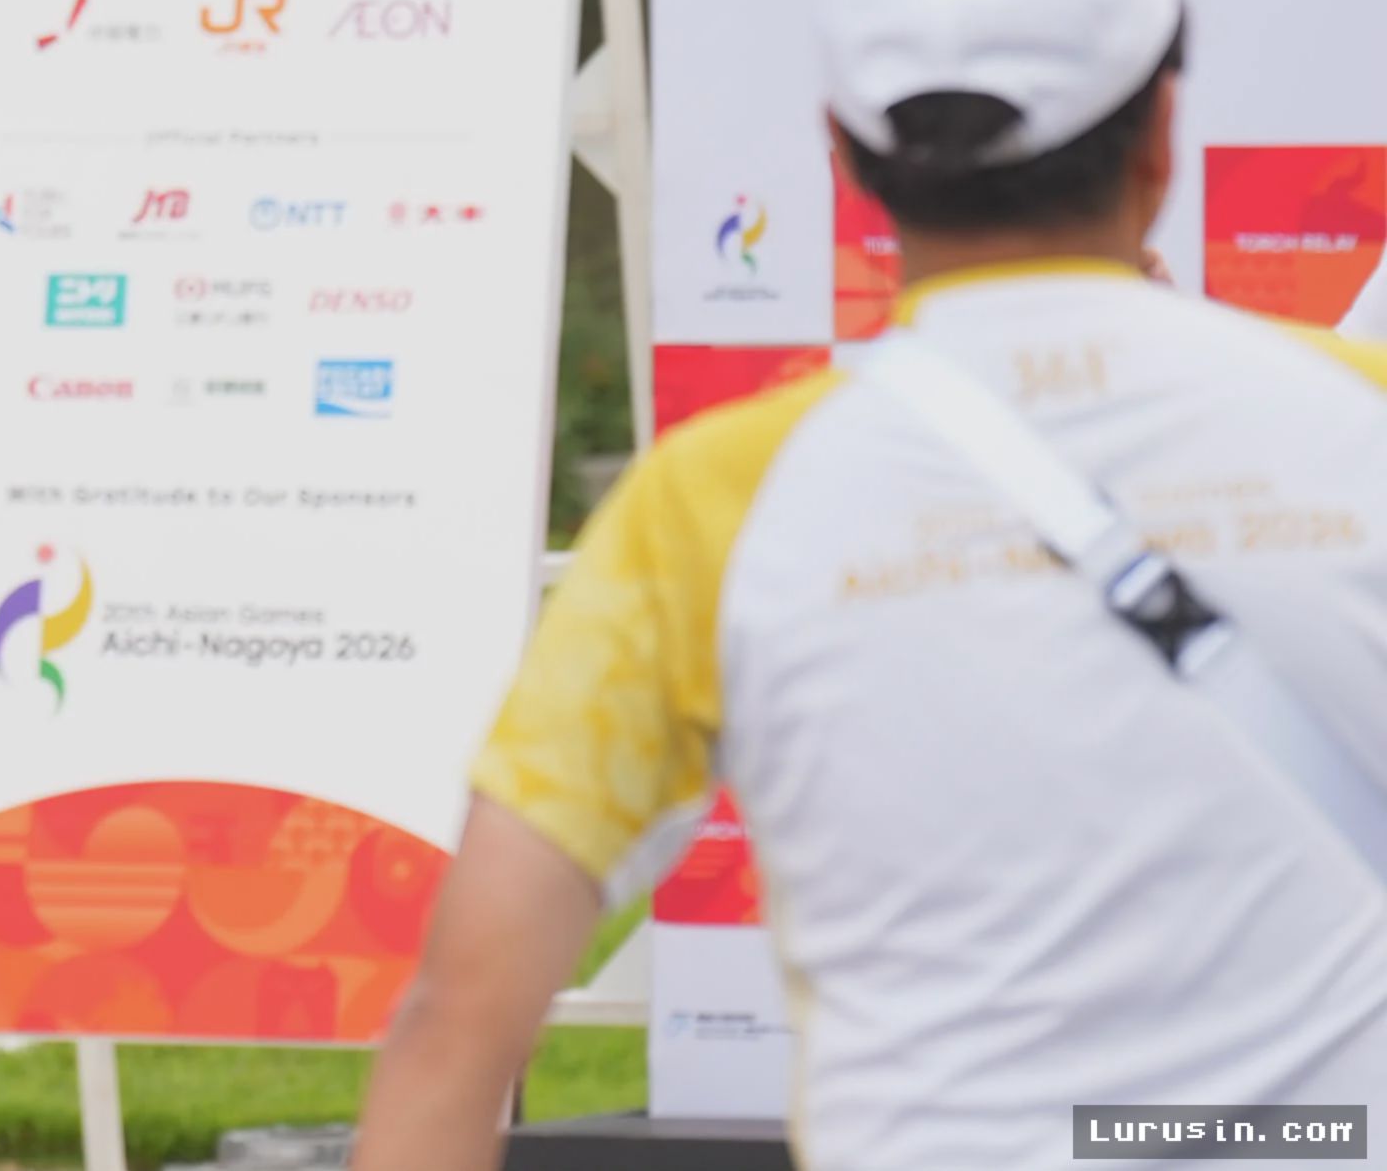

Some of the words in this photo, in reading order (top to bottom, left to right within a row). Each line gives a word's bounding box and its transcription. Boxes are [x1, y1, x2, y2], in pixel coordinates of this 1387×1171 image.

[132, 188, 190, 224] JTB
[283, 200, 347, 227] NTT
[309, 289, 414, 313] DENSO
[28, 375, 133, 400] Canon
[7, 487, 63, 505] With
[73, 486, 196, 505] Gratitude
[207, 487, 232, 505] to
[243, 488, 288, 505] Our
[297, 488, 416, 507] Sponsors
[165, 604, 227, 622] Asian
[238, 604, 324, 622] Games
[102, 631, 323, 666] Aichi-Nagoya
[334, 632, 416, 660] 2026
